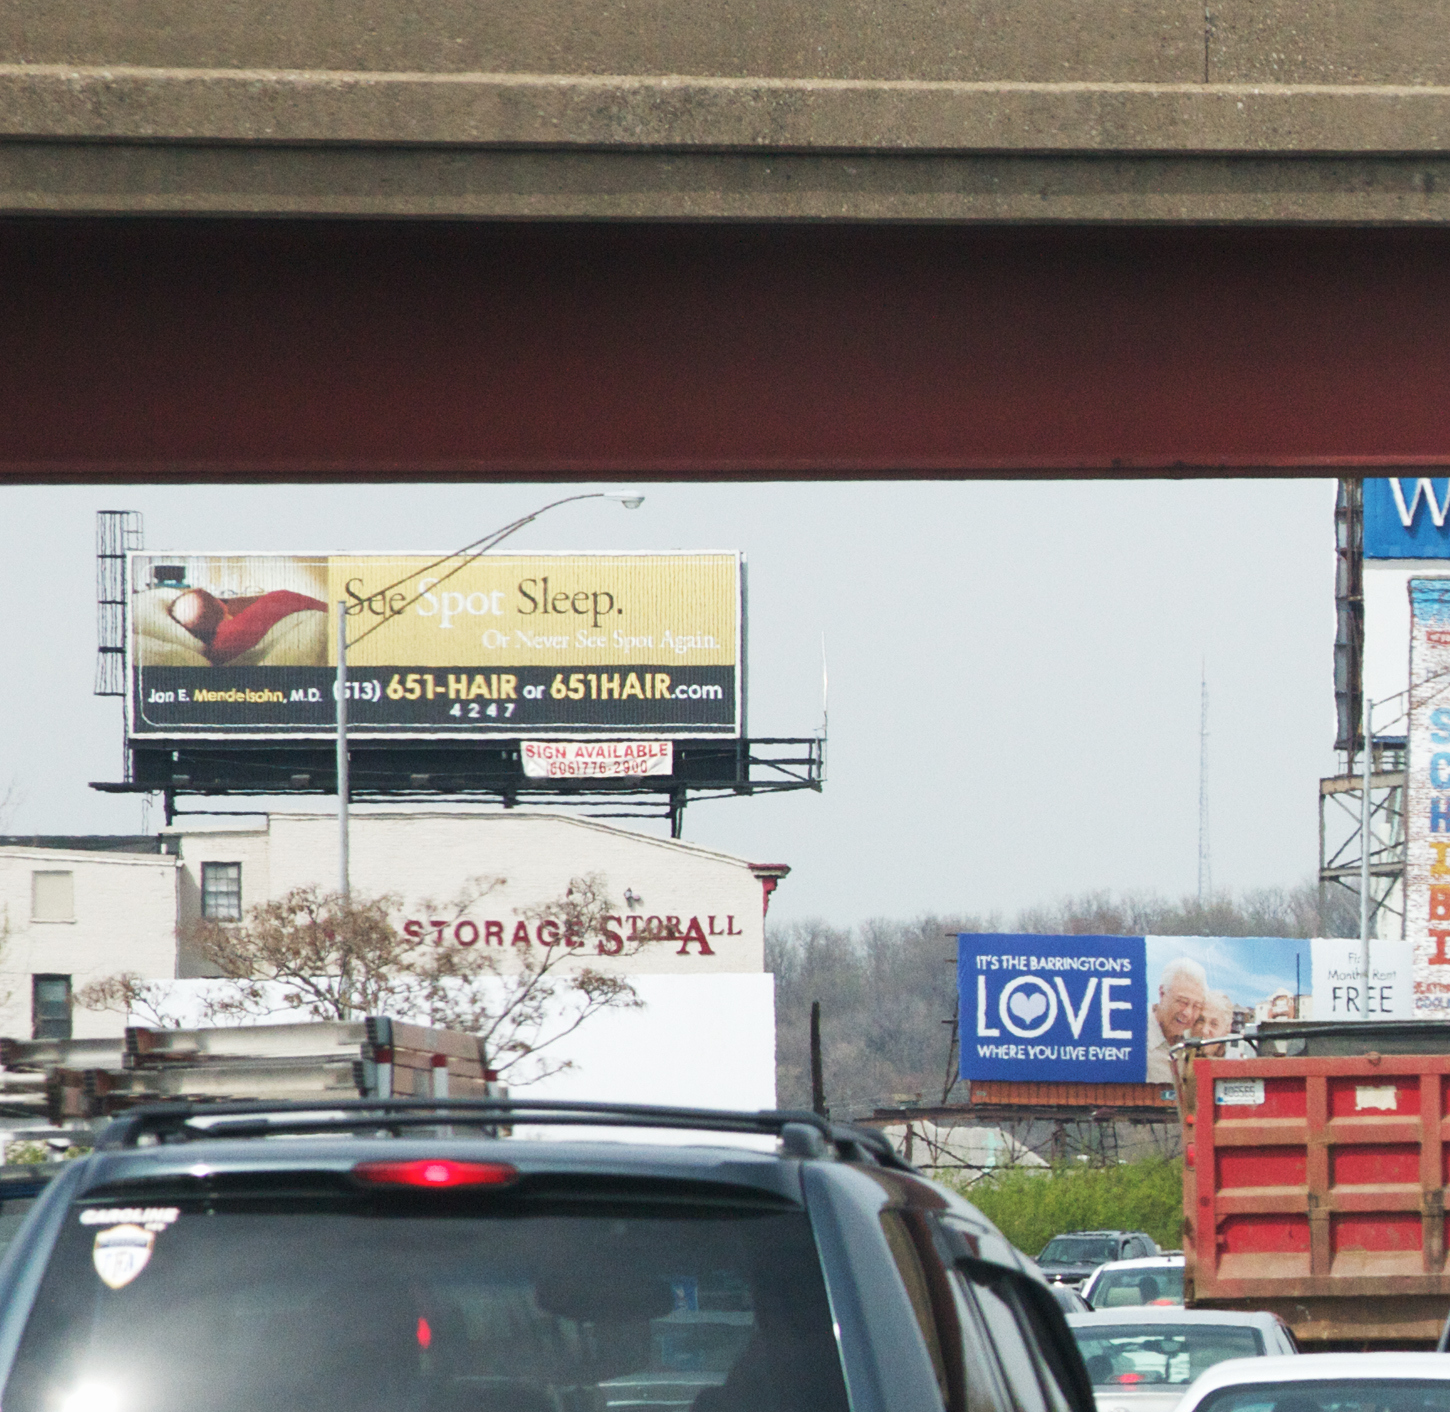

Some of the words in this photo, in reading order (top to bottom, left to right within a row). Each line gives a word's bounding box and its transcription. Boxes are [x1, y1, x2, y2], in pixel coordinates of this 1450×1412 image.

[344, 577, 406, 616] See
[415, 576, 505, 629] Spot
[516, 576, 624, 628] Sleep.
[482, 629, 510, 650] Or
[515, 629, 569, 649] Never
[574, 629, 607, 649] See
[612, 629, 654, 654] Spot
[660, 629, 721, 655] Again.
[148, 688, 175, 703] Jon
[177, 689, 190, 702] E.
[193, 688, 288, 704] Mendelsohn,
[290, 688, 323, 702] M.D.
[385, 673, 518, 702] 651-HAIR
[522, 682, 545, 700] or
[550, 672, 723, 701] 651HAIR.com
[525, 744, 567, 759] SIGN
[574, 742, 669, 759] AVAILABLE
[402, 919, 586, 948] STORAGE
[976, 955, 1000, 971] IT'S
[1001, 955, 1028, 971] THE
[1029, 956, 1132, 972] BARRINGTON'S
[1372, 969, 1397, 981] Rent
[976, 975, 1133, 1040] LOVE
[976, 1044, 1026, 1060] WHERE
[1028, 1045, 1058, 1060] YOU
[1060, 1046, 1086, 1061] LIVE
[1088, 1046, 1132, 1061] EVENT
